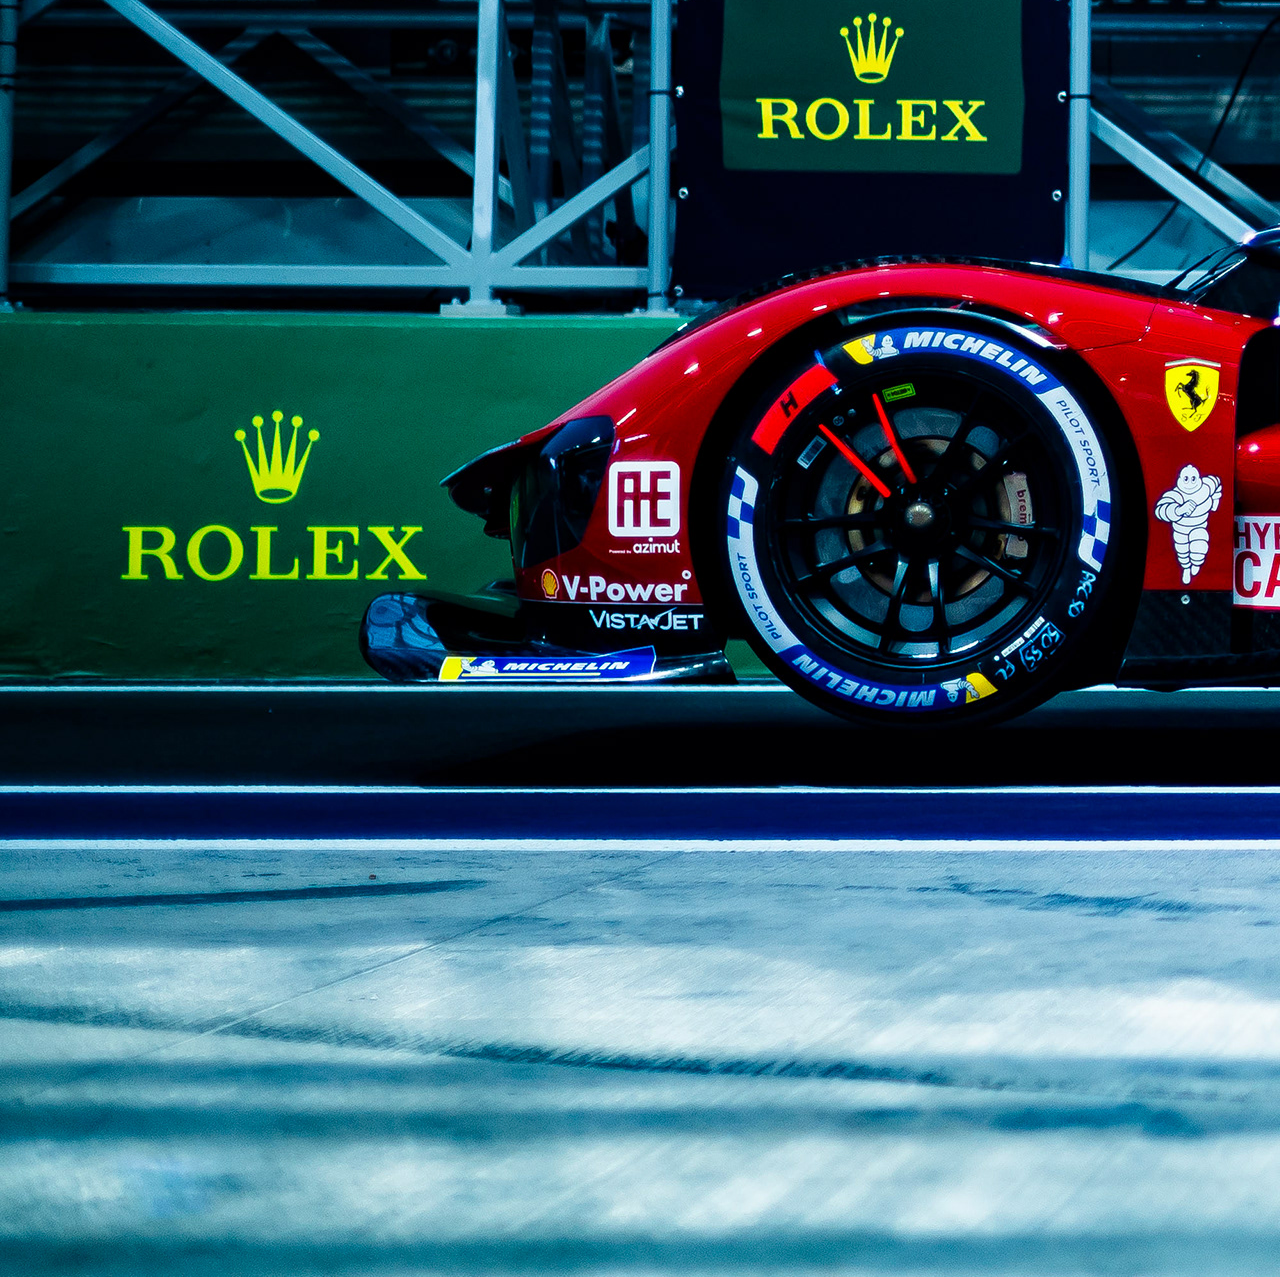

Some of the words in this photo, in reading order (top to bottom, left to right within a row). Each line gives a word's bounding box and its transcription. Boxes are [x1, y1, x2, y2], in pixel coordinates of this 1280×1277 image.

[756, 98, 987, 141] ROLEX
[903, 330, 1049, 386] MICHELIN
[780, 391, 798, 418] H
[1056, 399, 1086, 438] PILOT
[1079, 437, 1101, 486] SPORT
[121, 525, 427, 582] ROLEX
[633, 537, 680, 554] azimut
[562, 575, 687, 602] V-Power
[738, 554, 758, 599] SPORT
[752, 603, 782, 640] PILOT
[503, 662, 630, 671] MICHELIN
[792, 653, 936, 707] MICHELIN
